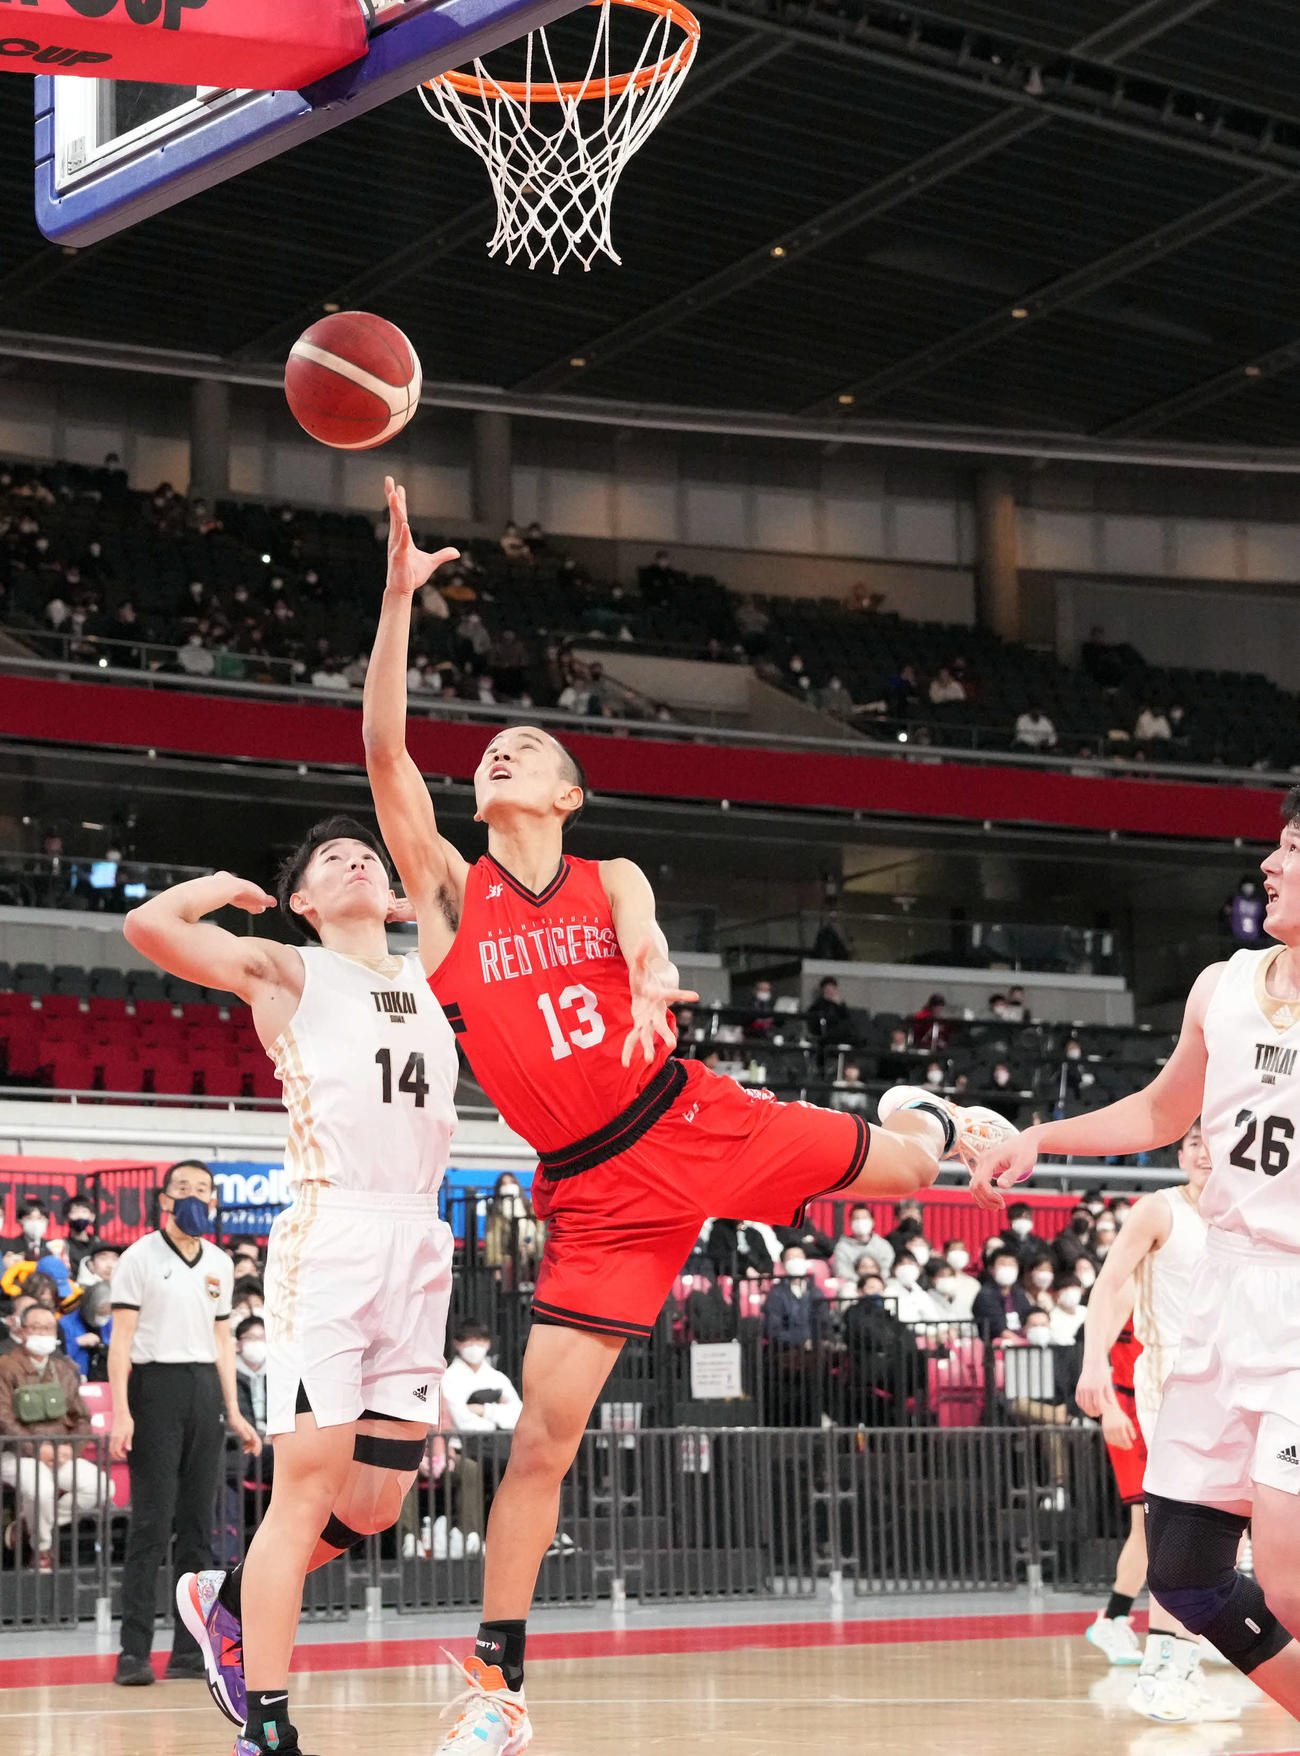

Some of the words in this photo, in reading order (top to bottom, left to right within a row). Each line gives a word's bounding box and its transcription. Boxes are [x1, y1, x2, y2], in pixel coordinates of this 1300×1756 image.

[0, 38, 113, 66] CUP
[479, 934, 533, 983] RED
[527, 925, 618, 970] TIGERS
[370, 991, 418, 1014] TOKAI
[537, 984, 606, 1061] 13
[375, 1048, 430, 1108] 14
[1255, 1043, 1298, 1076] TOKAI
[1230, 1108, 1295, 1177] 26
[1276, 1453, 1299, 1465] adidas
